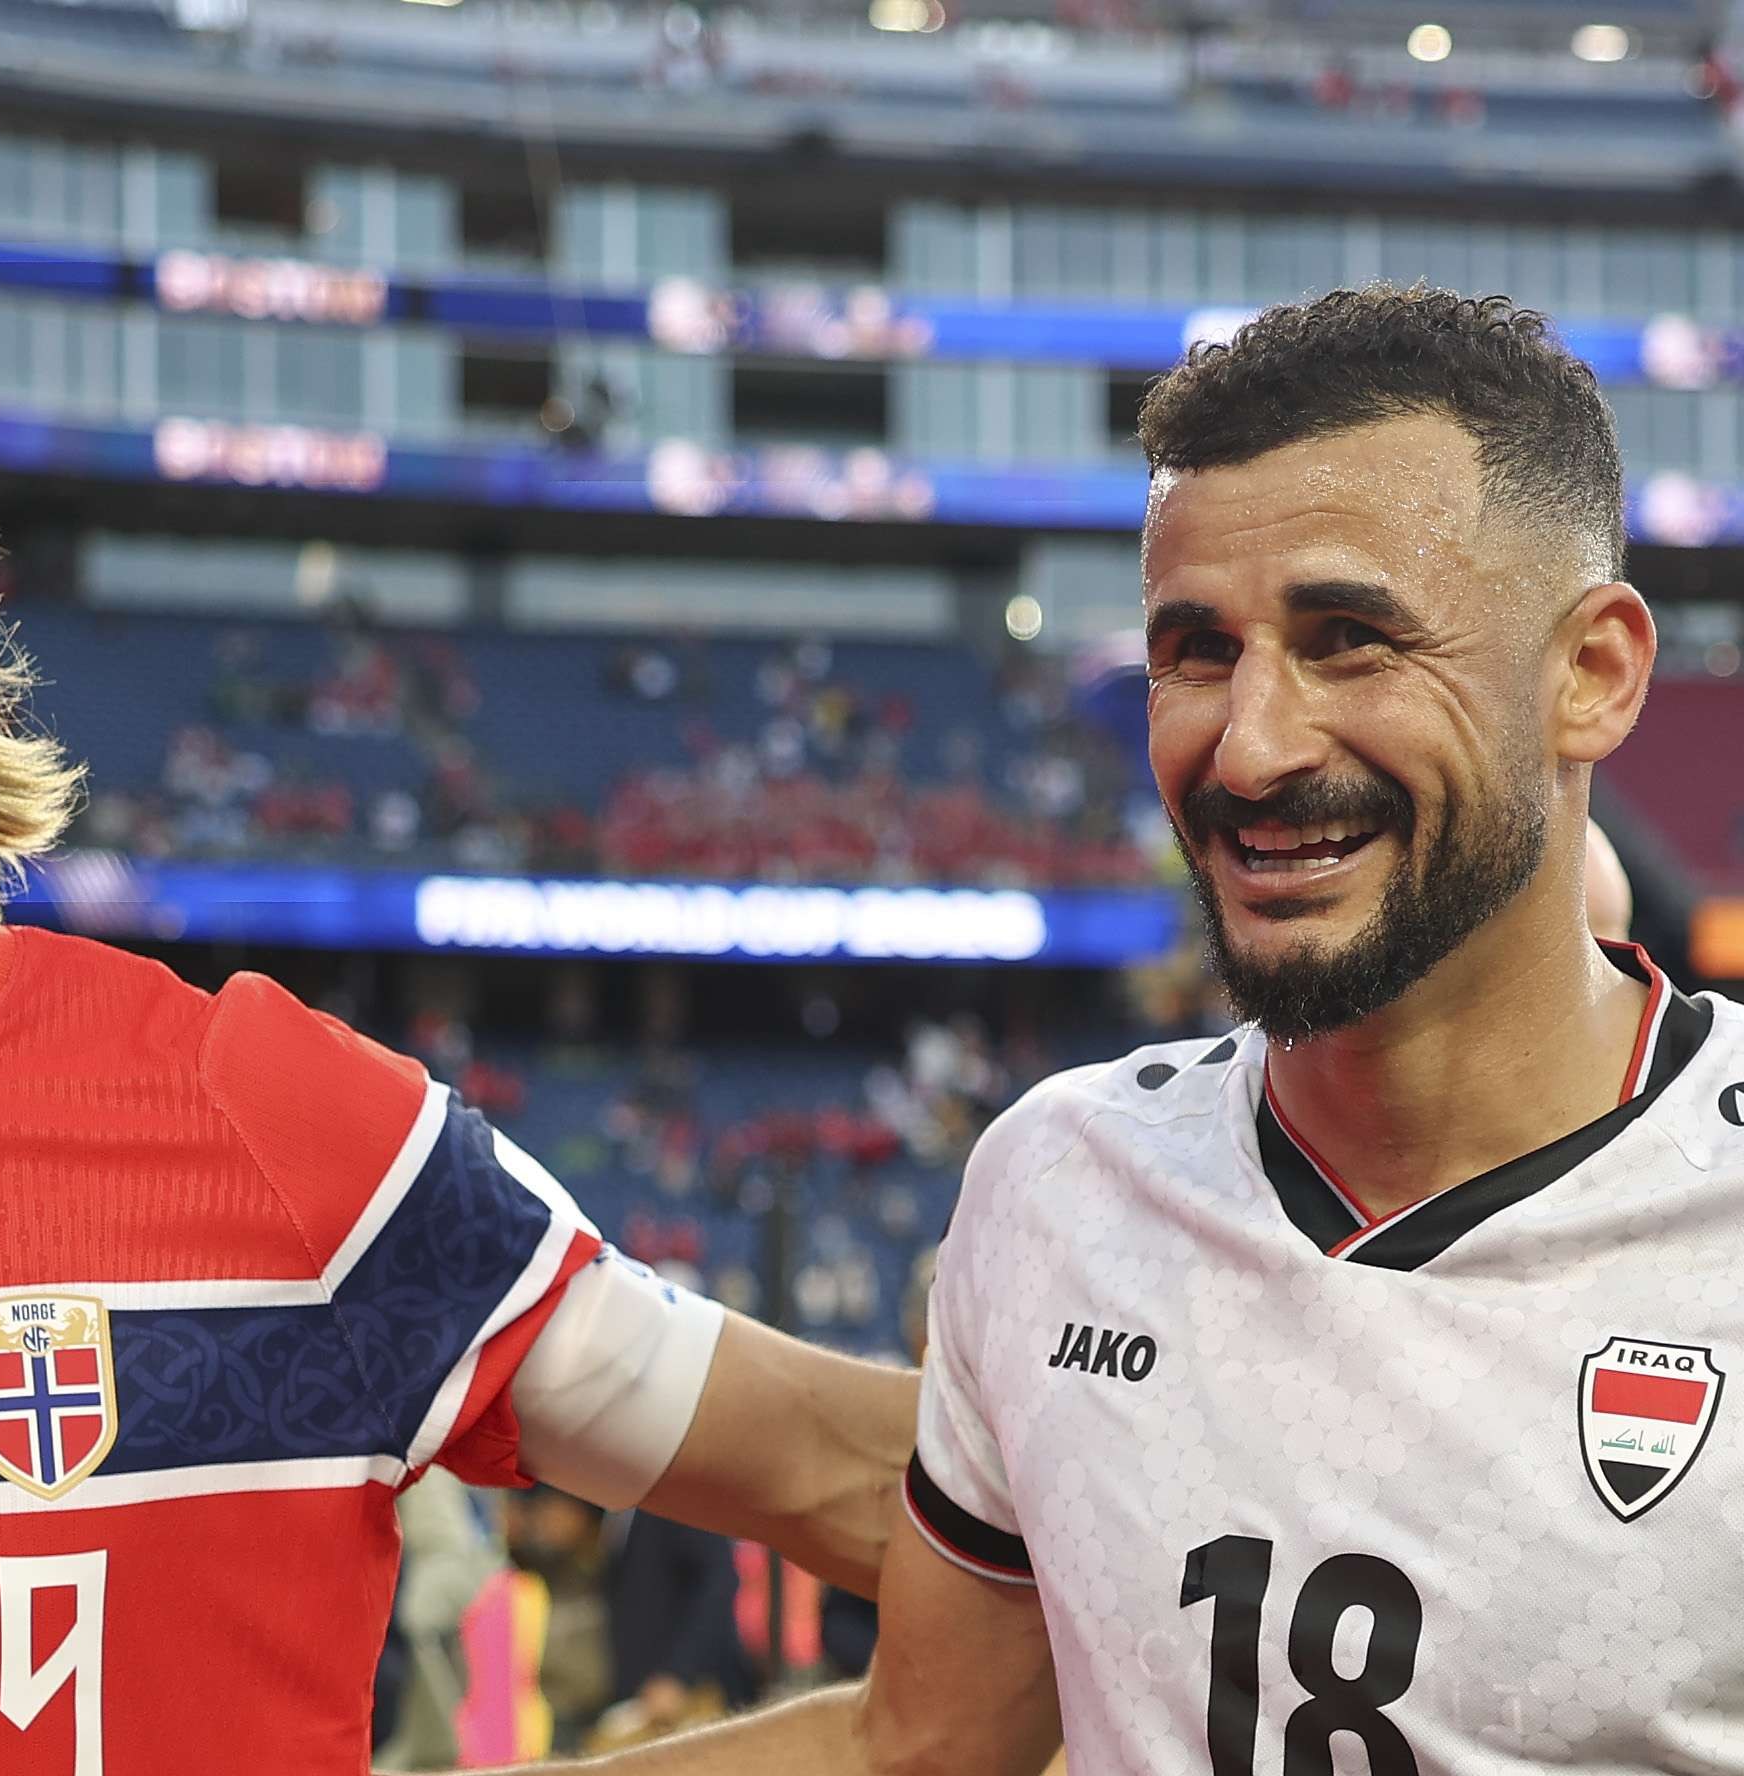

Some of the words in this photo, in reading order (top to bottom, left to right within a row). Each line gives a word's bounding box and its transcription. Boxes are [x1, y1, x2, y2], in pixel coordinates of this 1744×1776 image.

[12, 1303, 57, 1322] NORGE
[1048, 1322, 1157, 1382] JAKO
[1616, 1348, 1695, 1373] IRAQ
